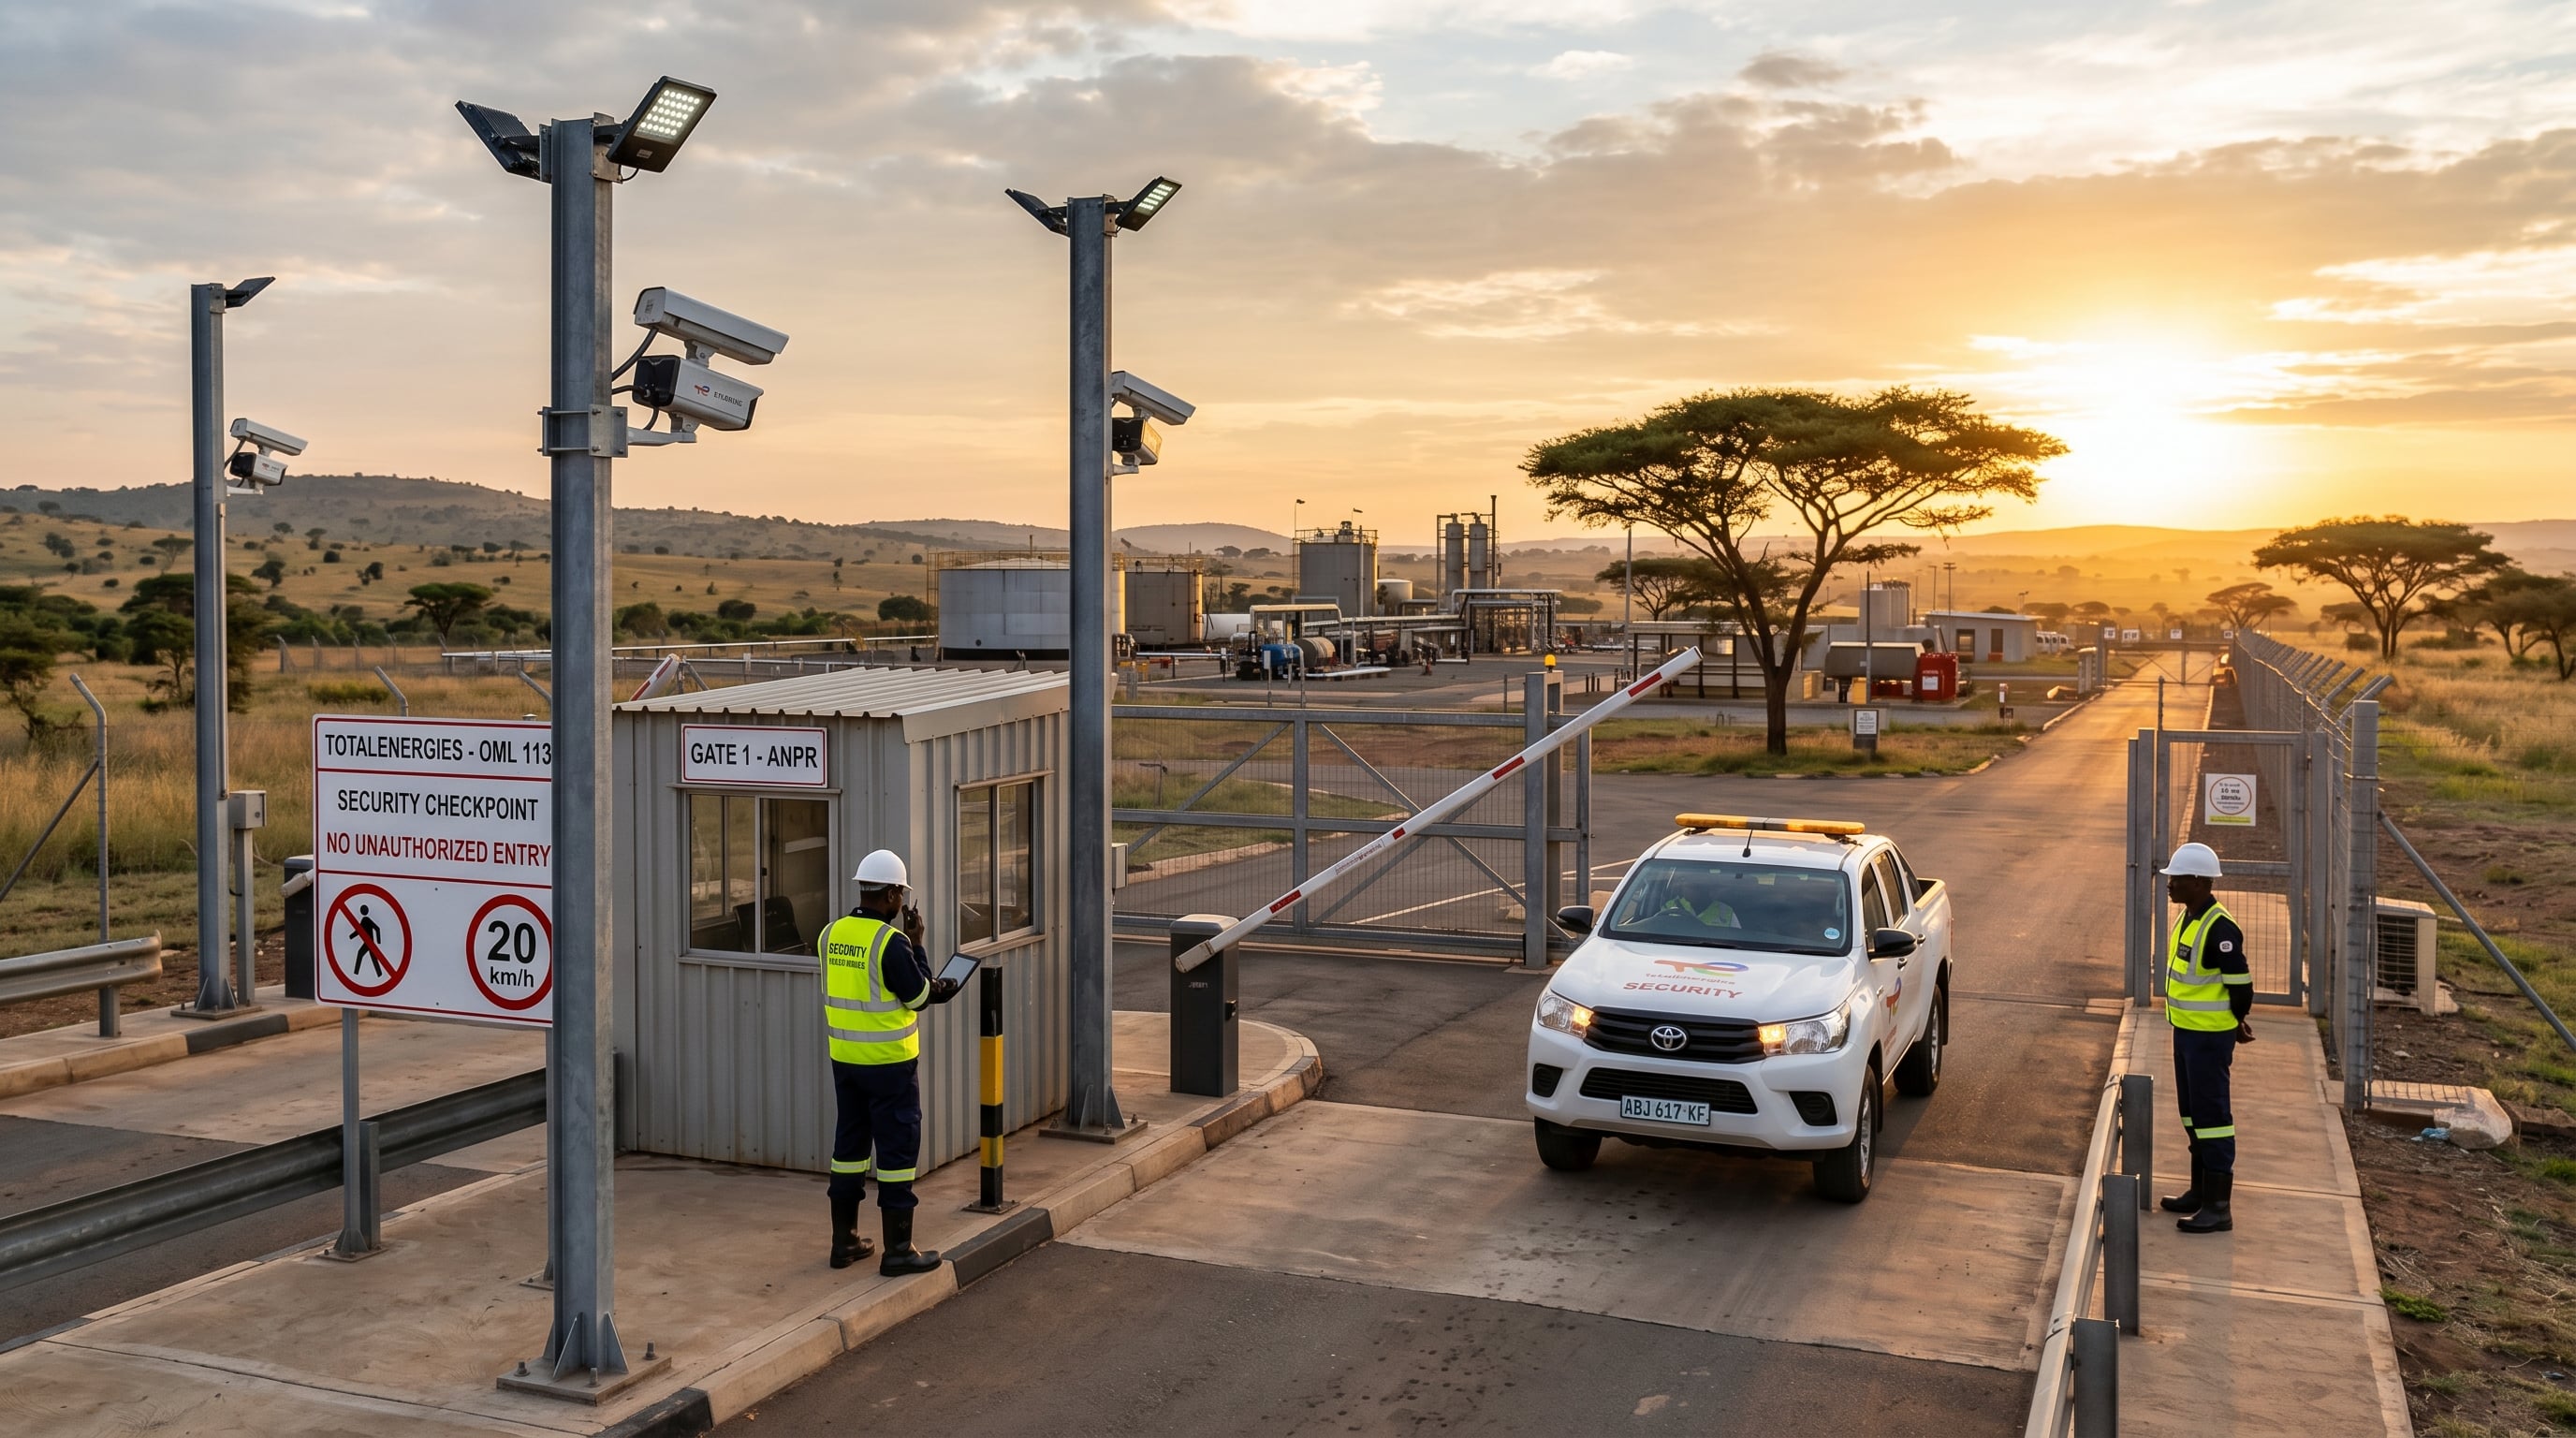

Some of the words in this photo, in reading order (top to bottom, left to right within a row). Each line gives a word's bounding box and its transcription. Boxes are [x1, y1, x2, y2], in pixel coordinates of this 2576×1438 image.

[325, 735, 462, 760] TOTALENERGIES
[480, 741, 517, 763] OML
[523, 741, 551, 765] 113
[691, 743, 737, 765] GATE
[742, 745, 749, 766] 1
[768, 746, 817, 768] ANPR
[338, 790, 420, 814] SECURITY
[426, 794, 538, 820] CHECKPOINT
[328, 832, 350, 854] NO
[356, 834, 488, 862] UNAUTHORIZED
[494, 843, 551, 867] ENTRY
[488, 920, 536, 964] 20
[490, 966, 534, 988] km/h
[1623, 981, 1742, 998] SECURITY
[1625, 1098, 1651, 1117] ABJ
[1655, 1102, 1682, 1120] 617
